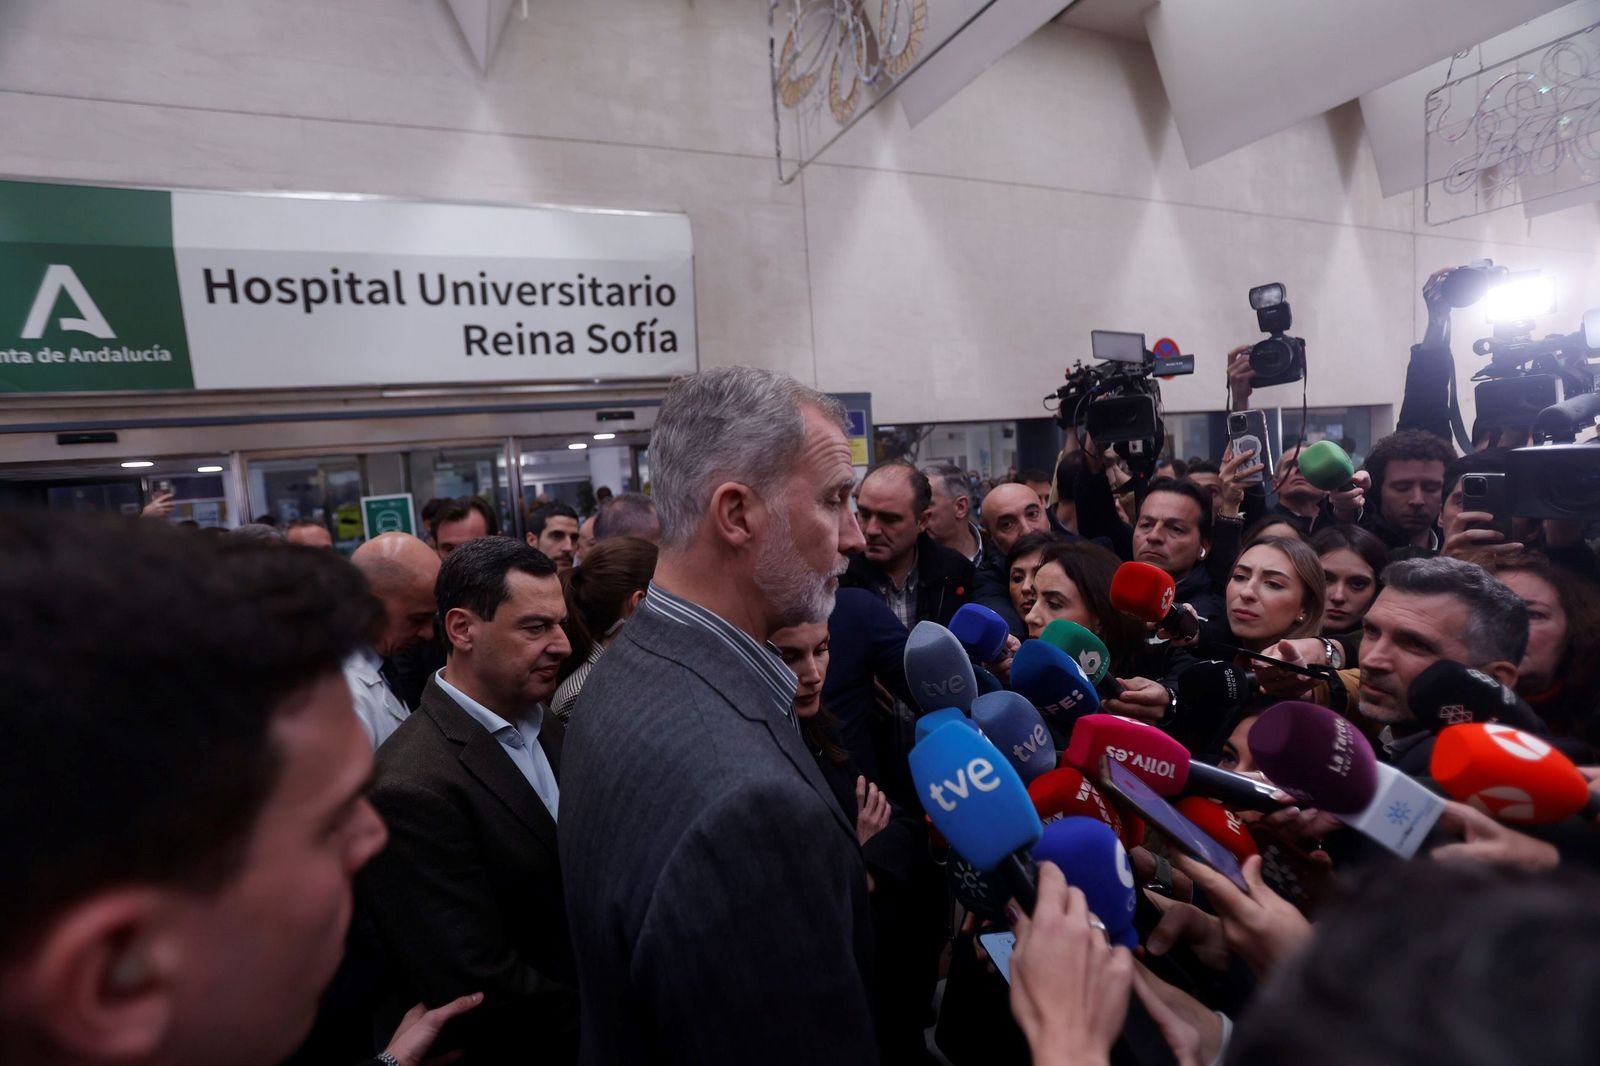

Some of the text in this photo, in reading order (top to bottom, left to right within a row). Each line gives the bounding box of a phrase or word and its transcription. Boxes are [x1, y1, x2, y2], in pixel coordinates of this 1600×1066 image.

[203, 267, 676, 313] Hospital Universitario
[37, 347, 66, 363] de
[69, 344, 173, 362] Andalucía
[463, 317, 678, 356] Reina Sofía
[921, 674, 966, 697] tve
[1012, 723, 1047, 762] tve
[929, 757, 1001, 812] tve
